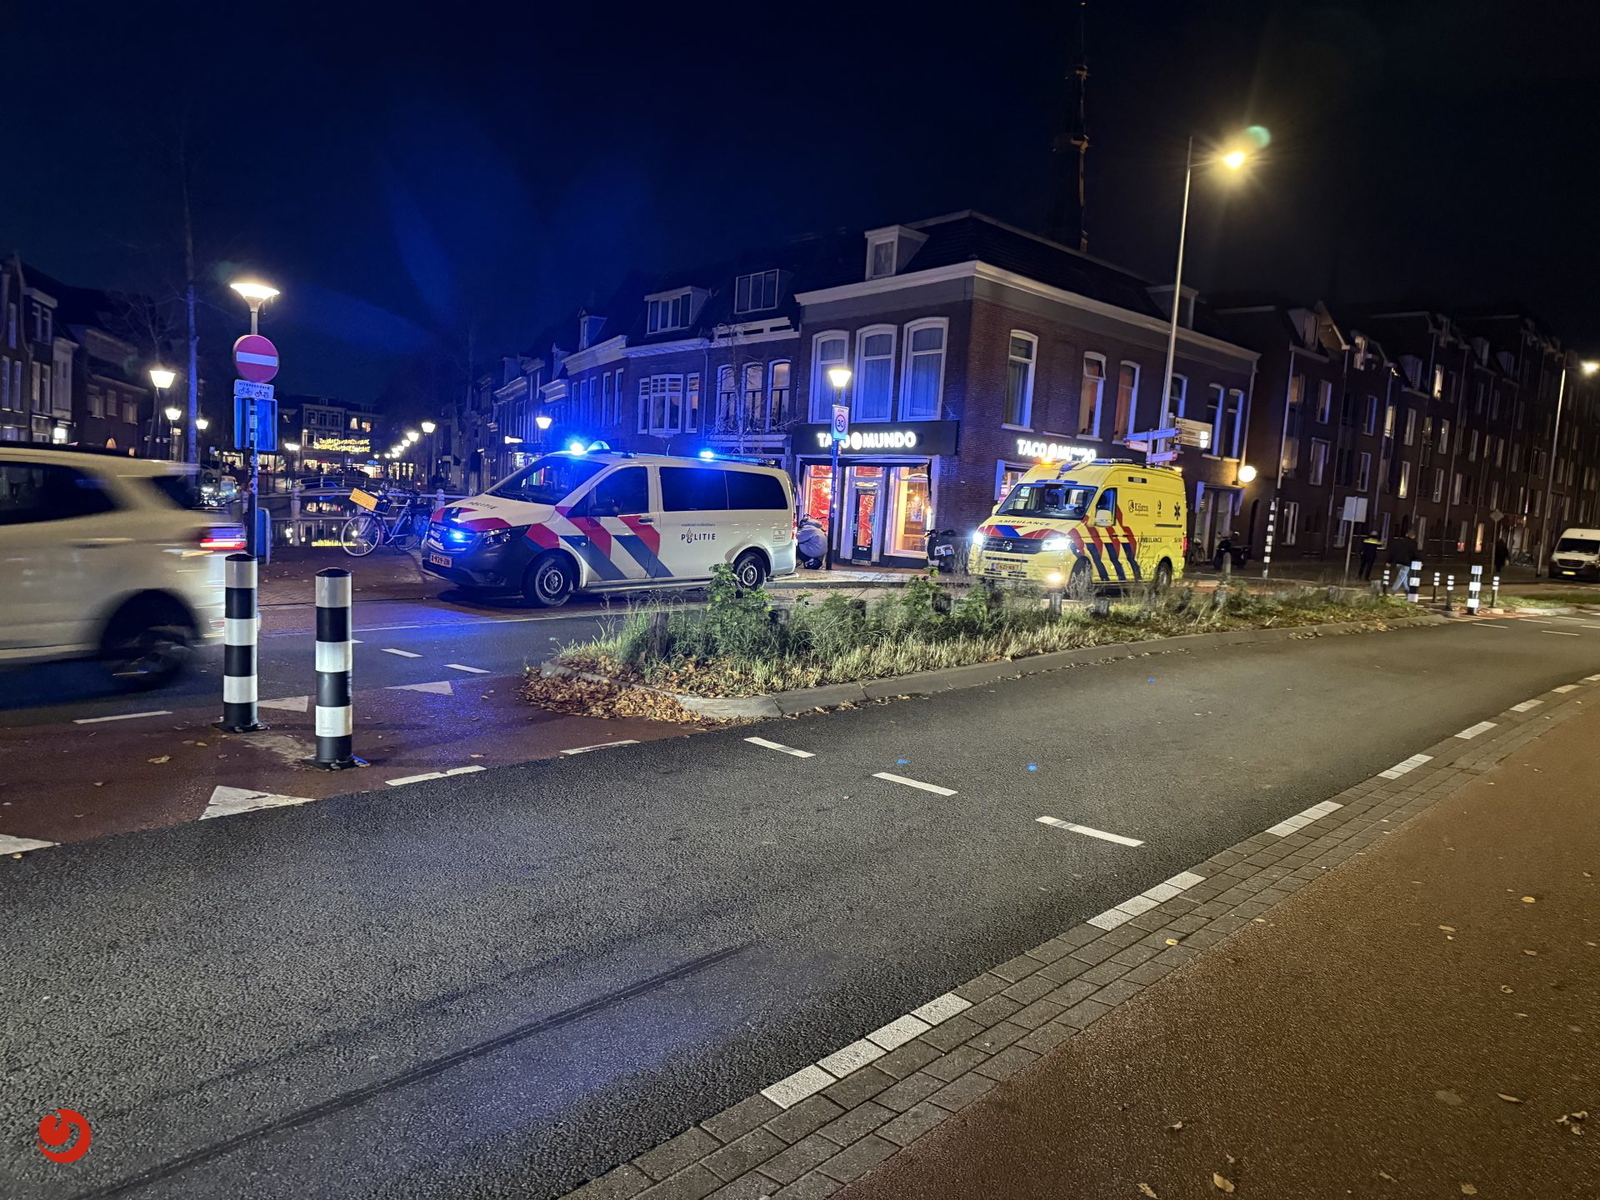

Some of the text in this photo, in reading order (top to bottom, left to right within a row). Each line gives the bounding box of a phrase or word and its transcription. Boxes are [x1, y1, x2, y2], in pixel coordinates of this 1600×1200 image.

[817, 431, 917, 448] TAO MUNDO
[1017, 439, 1047, 457] TACO
[681, 530, 716, 543] POLITIE
